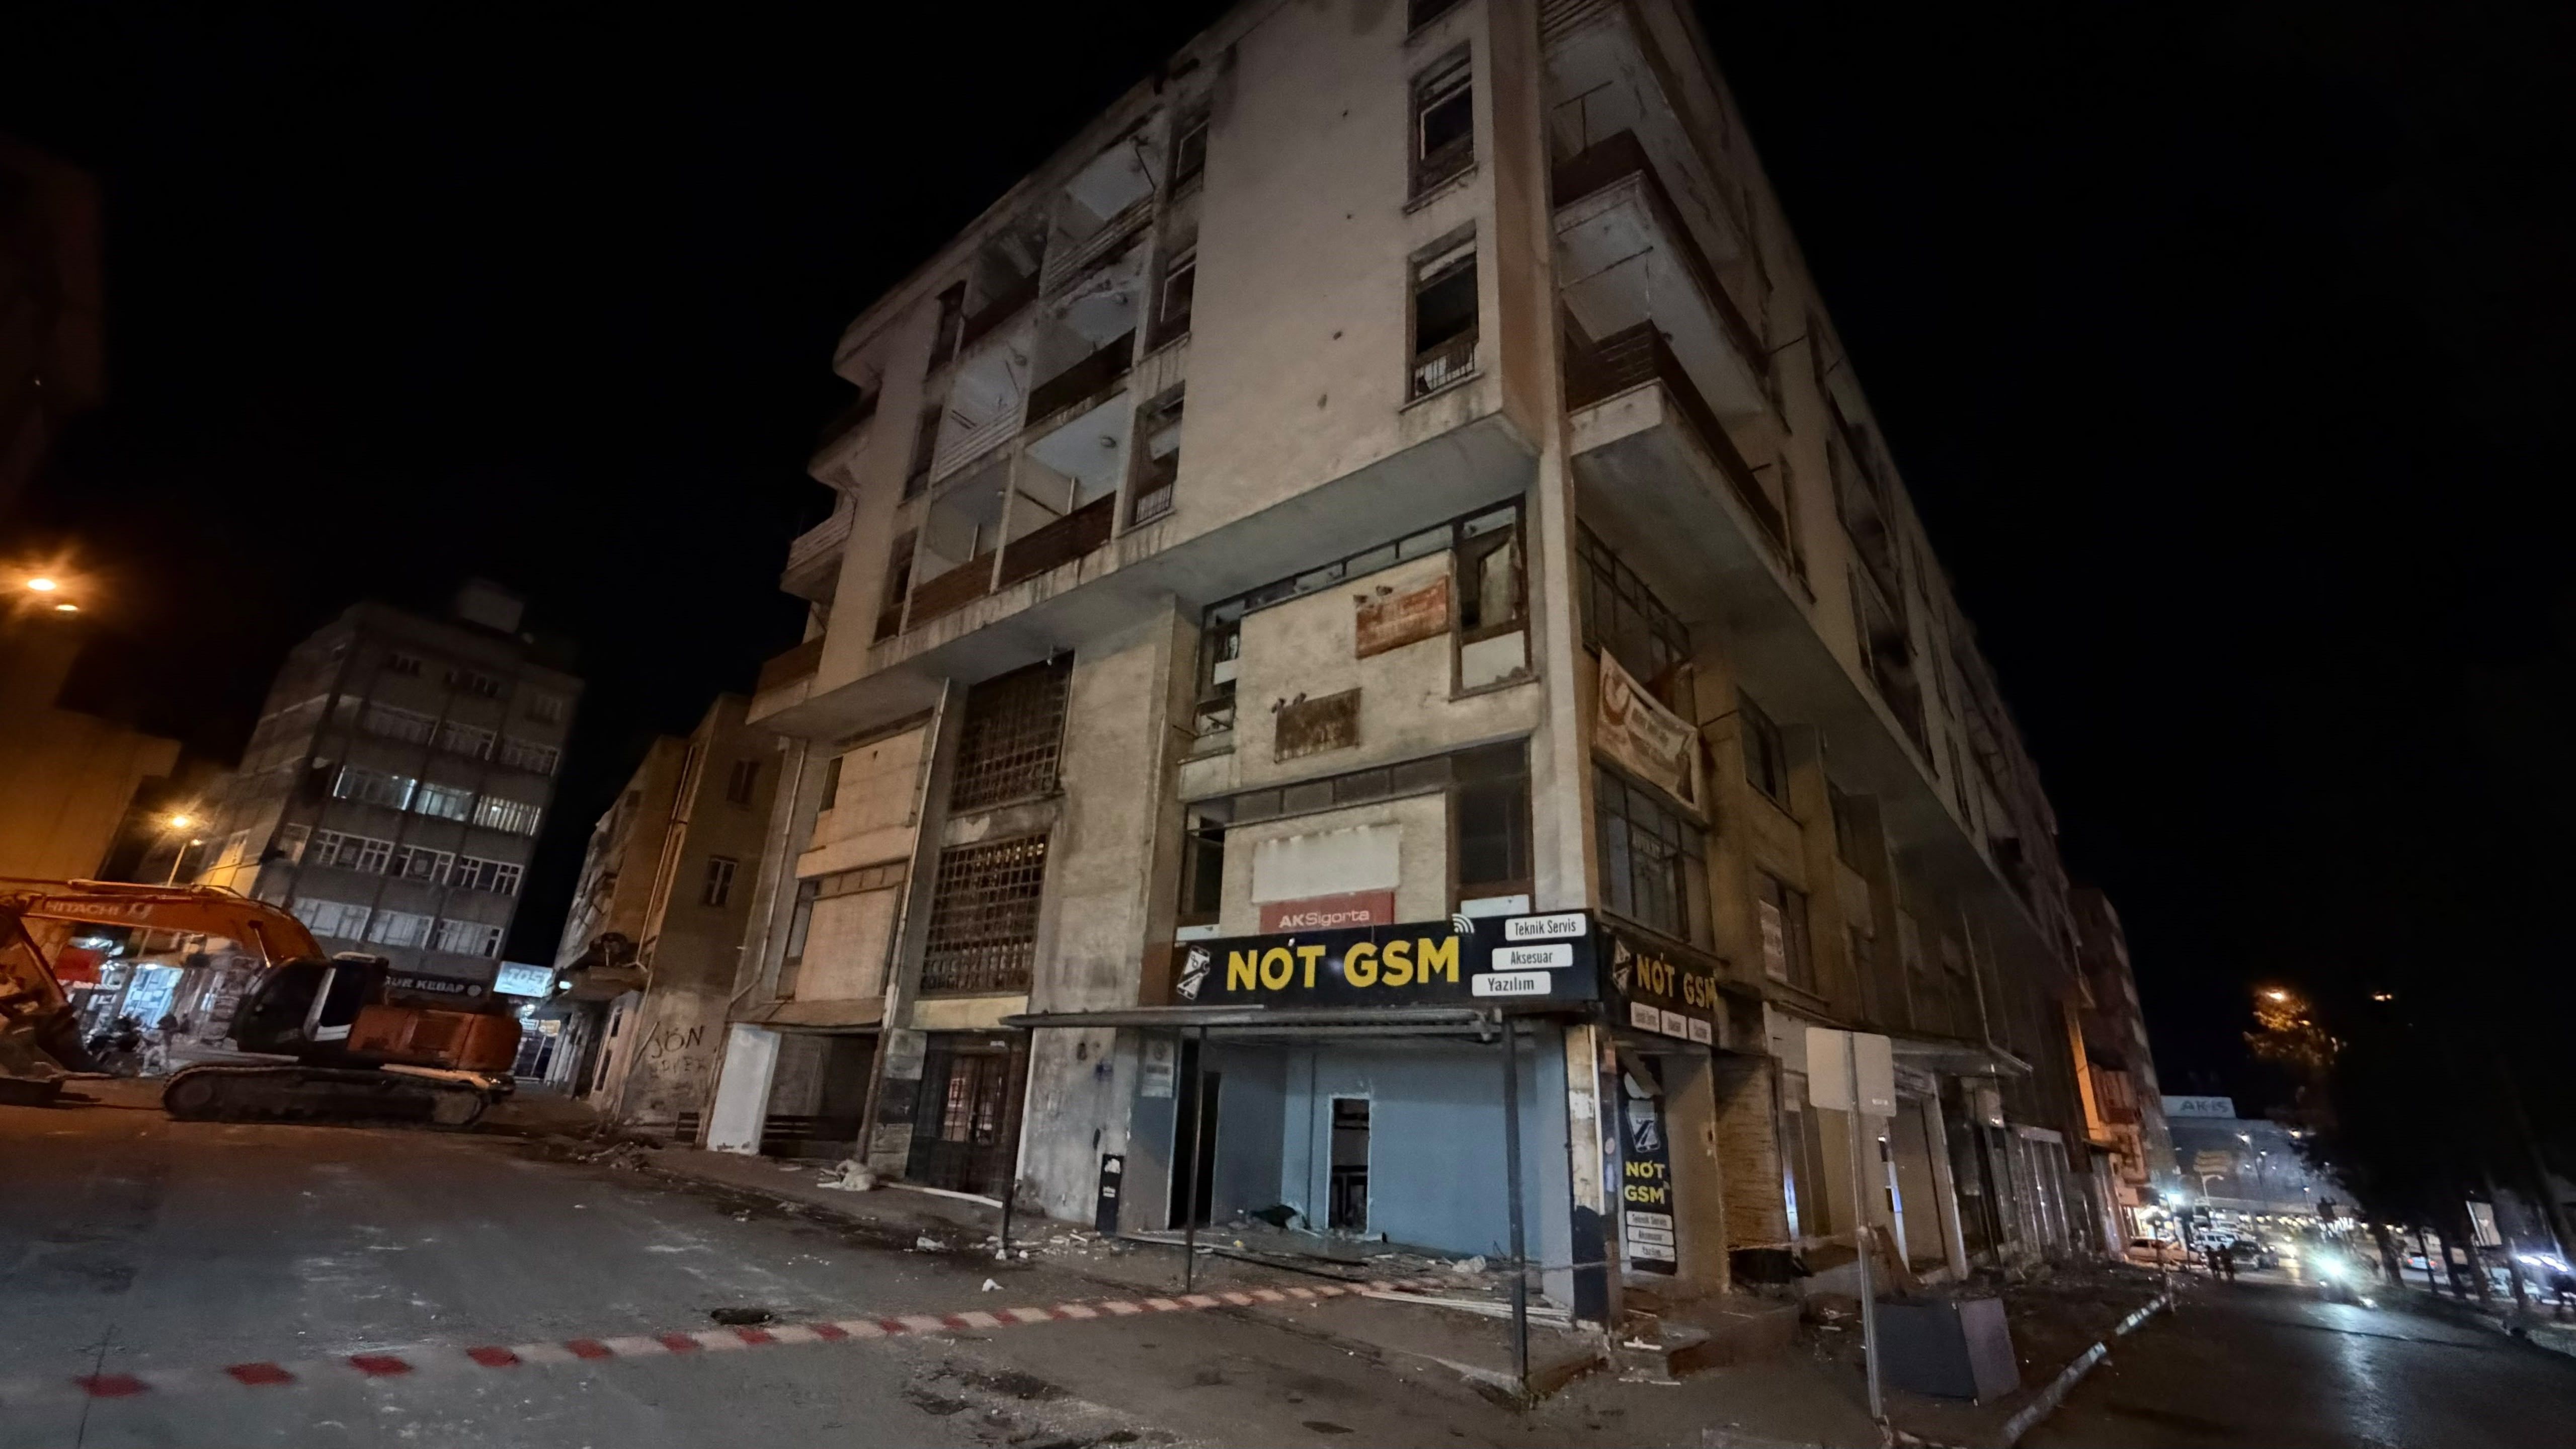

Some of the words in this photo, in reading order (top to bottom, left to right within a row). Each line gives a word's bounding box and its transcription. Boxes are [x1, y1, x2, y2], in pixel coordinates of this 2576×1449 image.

[44, 901, 119, 915] HITACHI
[1279, 910, 1370, 928] AKSigorta
[1514, 920, 1545, 936] Teknik
[1547, 918, 1576, 934] Servis
[1343, 936, 1459, 987] GSM
[1510, 951, 1553, 965] Aksesuar
[416, 980, 464, 993] KEBAP
[1487, 977, 1535, 992] Yazılım
[1683, 972, 1718, 1009] GSM
[1624, 1184, 1665, 1204] GSM
